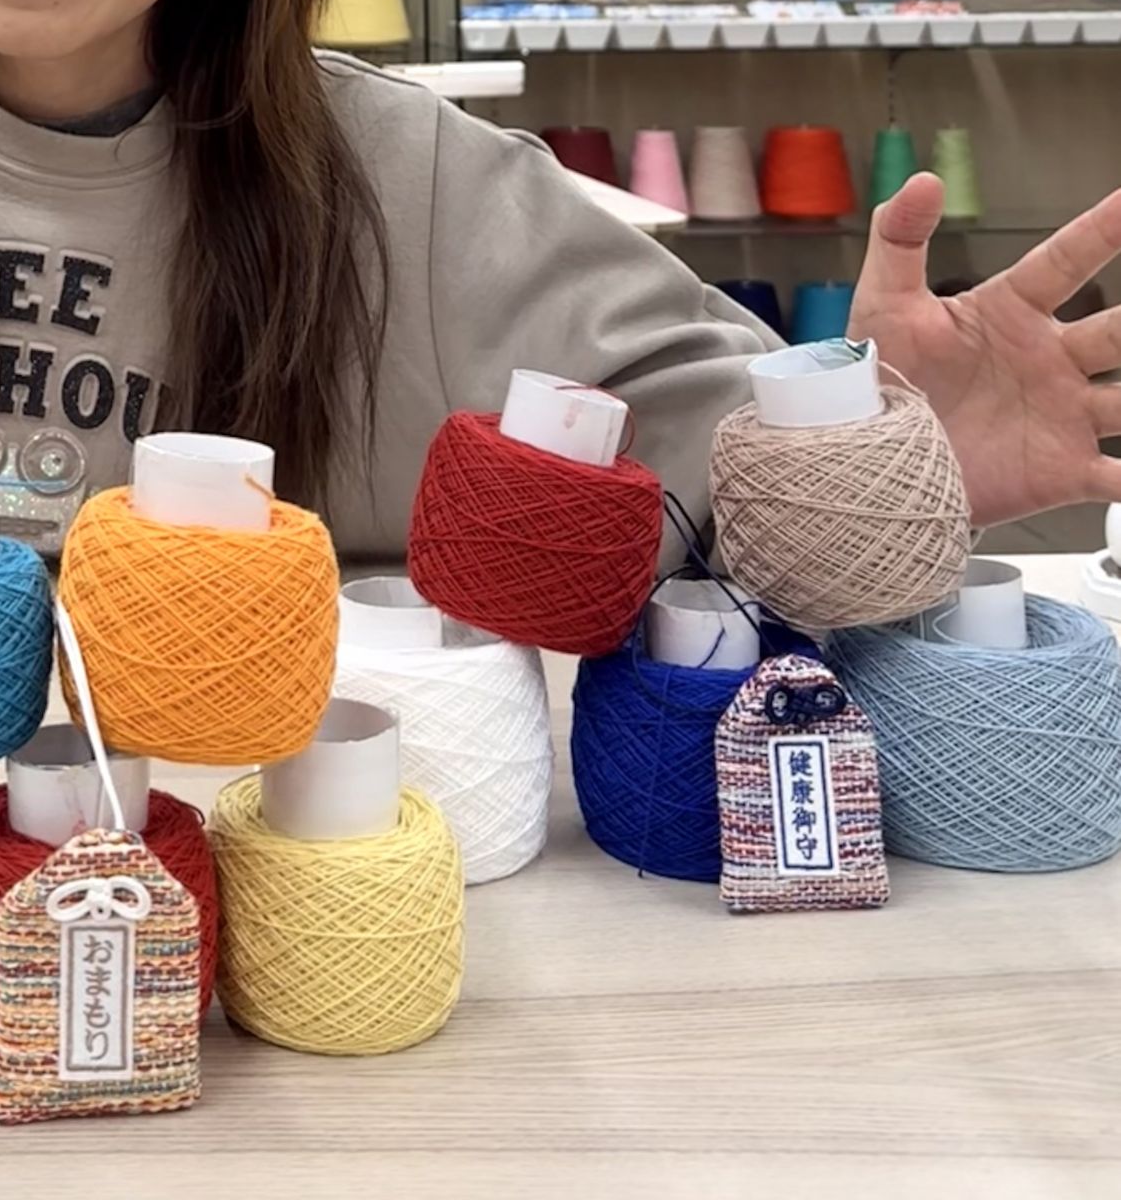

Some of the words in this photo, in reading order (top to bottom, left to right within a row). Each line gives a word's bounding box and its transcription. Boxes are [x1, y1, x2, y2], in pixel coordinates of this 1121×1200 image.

[787, 750, 819, 861] 健康御守
[81, 934, 115, 1061] おまもり
